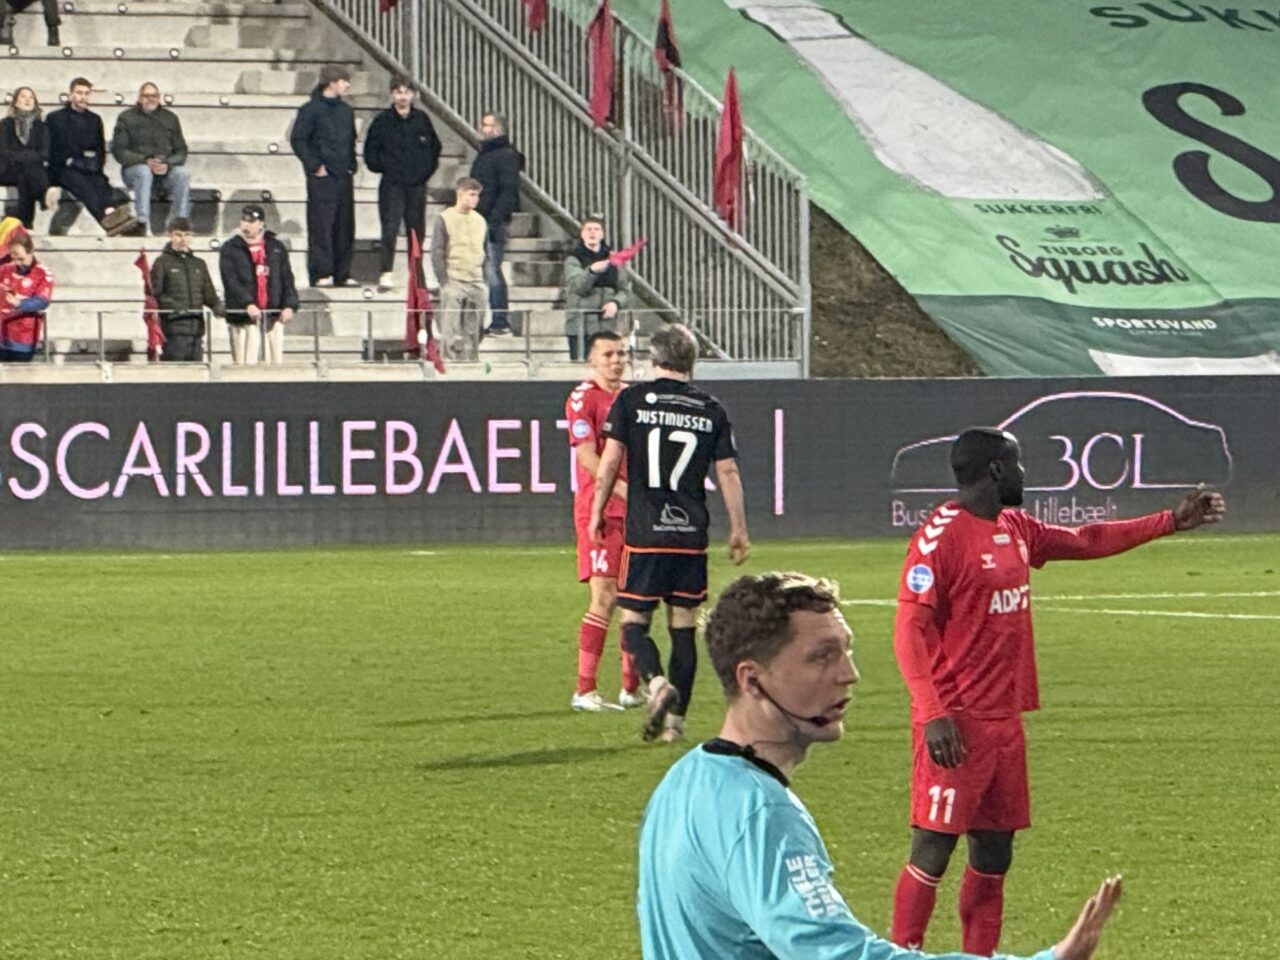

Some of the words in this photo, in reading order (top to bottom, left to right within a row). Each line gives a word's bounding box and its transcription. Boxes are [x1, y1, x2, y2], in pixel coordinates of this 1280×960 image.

[972, 203, 1103, 215] SUKKERFRI
[1038, 244, 1125, 257] TUBORG
[995, 234, 1190, 295] Squash
[1092, 316, 1218, 331] SPORTSVAND
[648, 427, 699, 492] 17
[928, 785, 956, 824] 11
